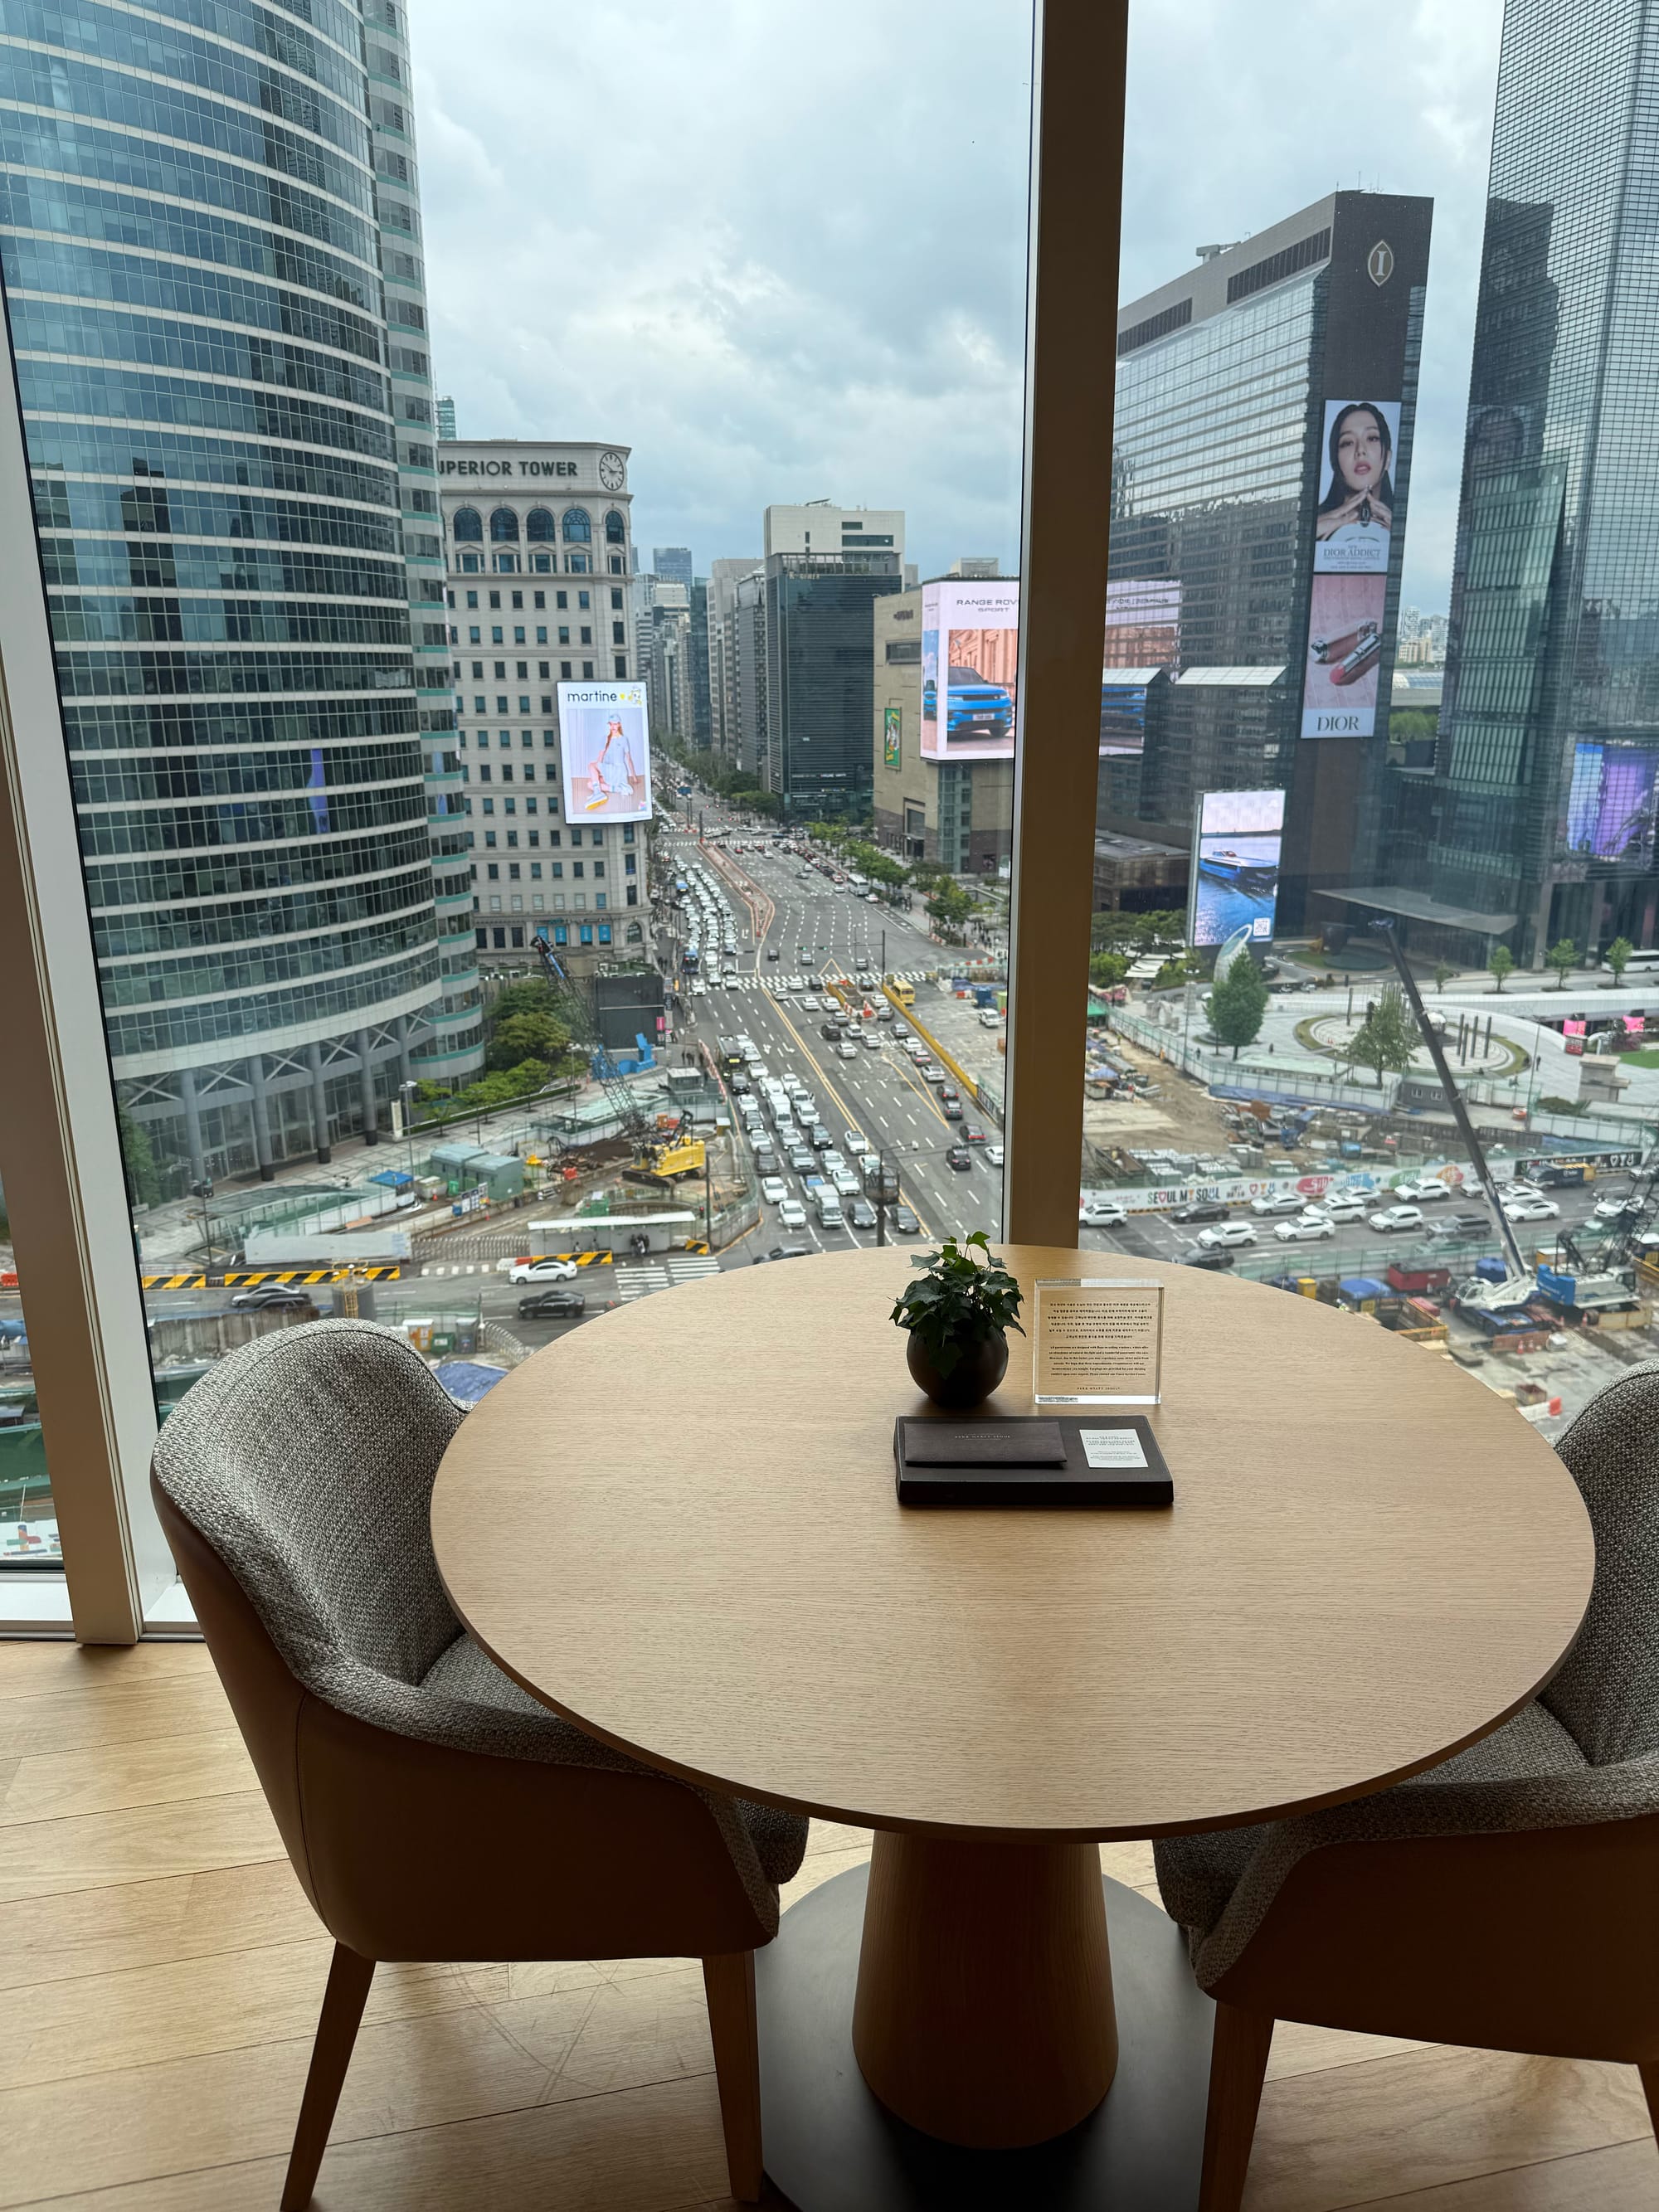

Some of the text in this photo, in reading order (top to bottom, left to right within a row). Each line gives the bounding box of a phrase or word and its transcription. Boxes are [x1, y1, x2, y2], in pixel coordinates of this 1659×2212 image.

[519, 461, 578, 476] TOWER
[567, 690, 617, 702] martine
[1316, 716, 1360, 732] DIOR
